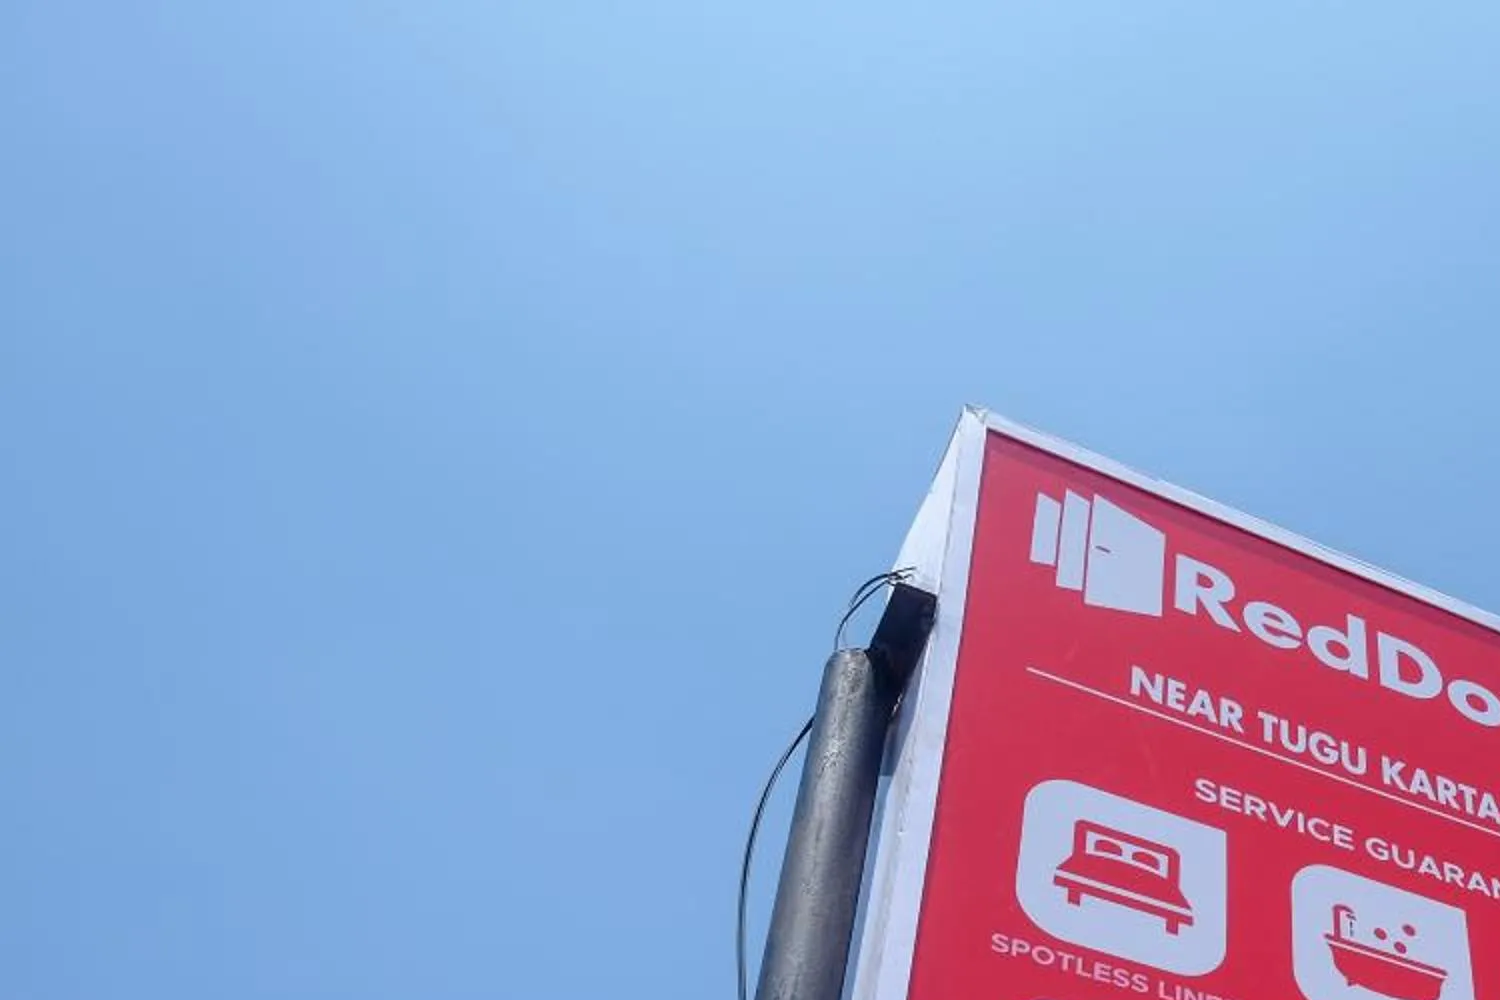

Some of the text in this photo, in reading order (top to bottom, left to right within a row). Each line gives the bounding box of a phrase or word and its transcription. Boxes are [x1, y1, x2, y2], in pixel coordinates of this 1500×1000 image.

[1130, 665, 1244, 734] NEAR
[1257, 710, 1367, 776] TUGU
[1194, 778, 1354, 851] SERVICE
[991, 932, 1149, 993] SPOTLESS
